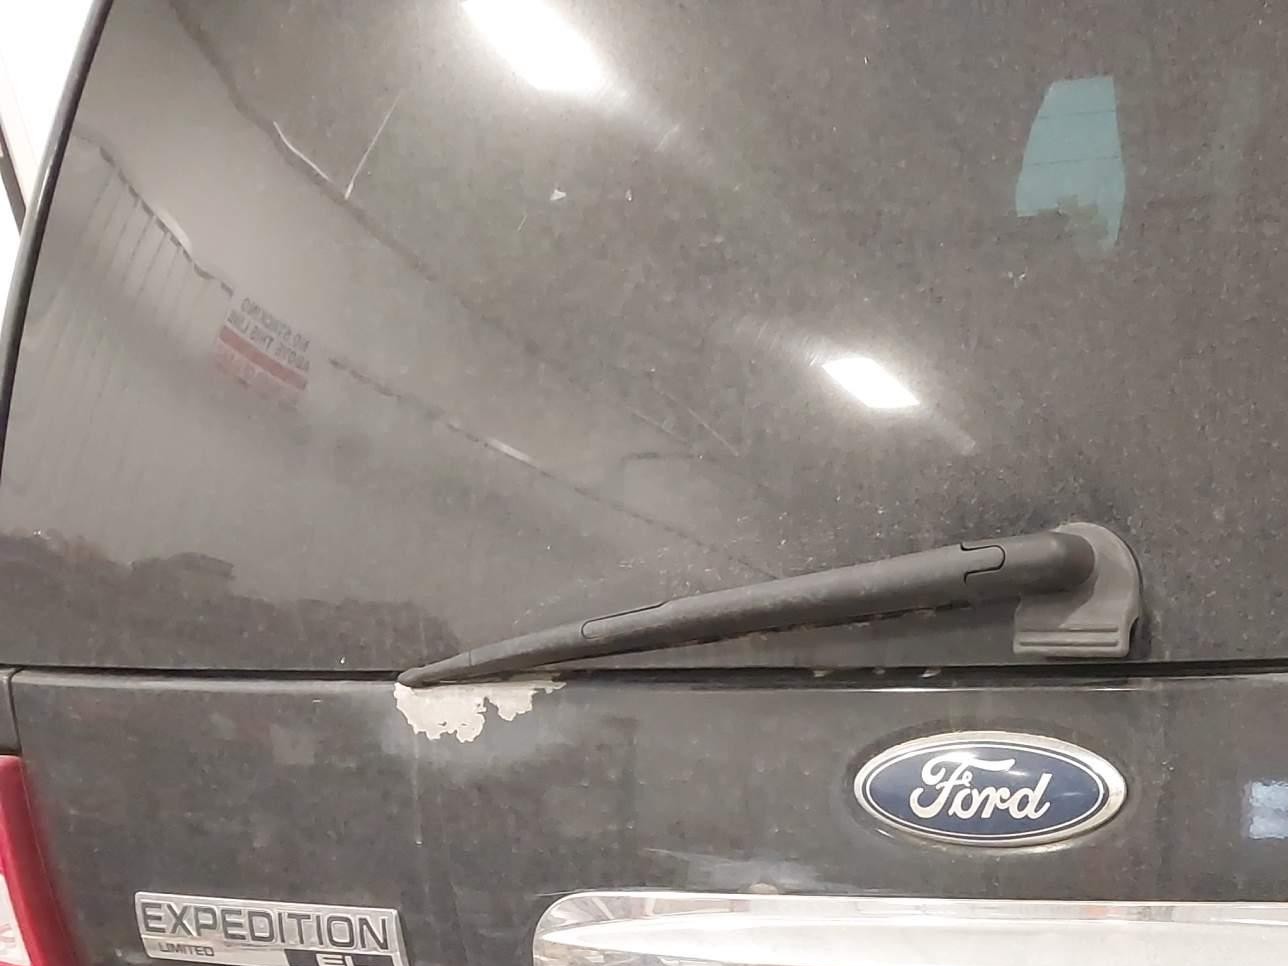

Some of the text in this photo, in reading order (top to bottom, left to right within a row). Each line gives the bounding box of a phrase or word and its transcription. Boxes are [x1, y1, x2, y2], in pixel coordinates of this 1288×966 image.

[909, 752, 1052, 819] Ford
[140, 901, 390, 950] EXPEDITION
[158, 942, 215, 957] LIMITED
